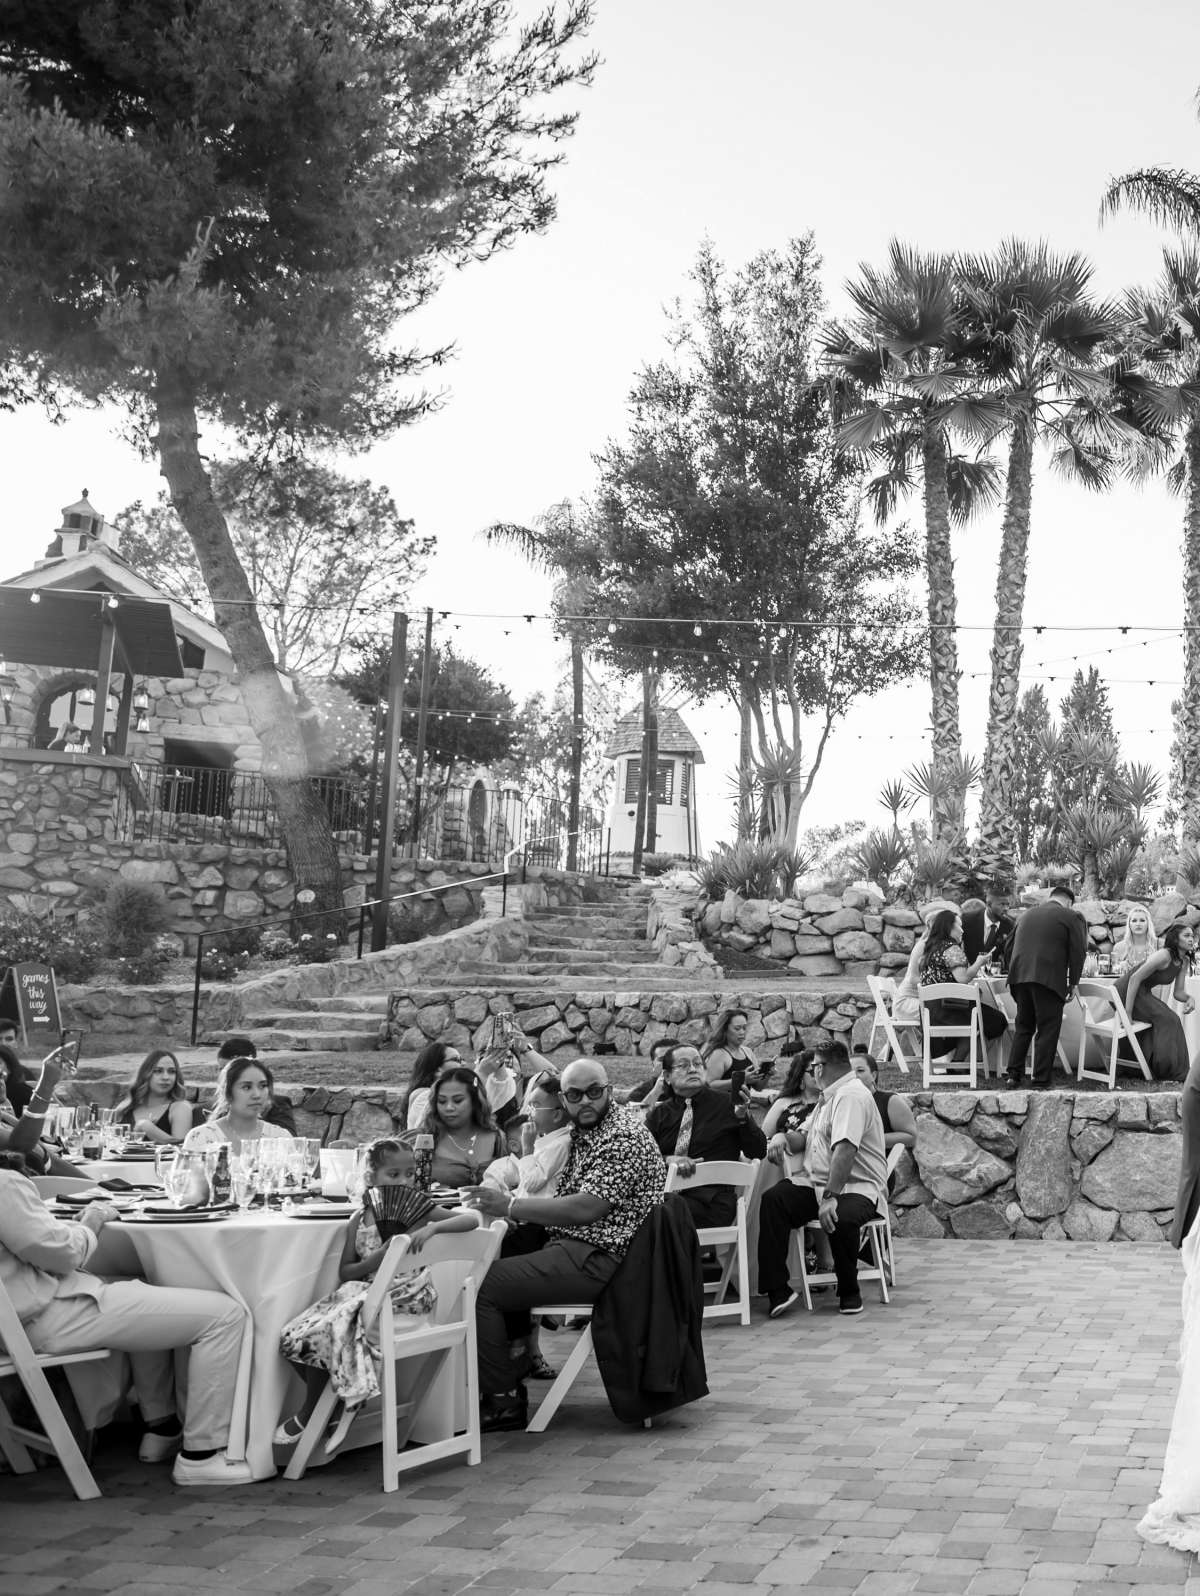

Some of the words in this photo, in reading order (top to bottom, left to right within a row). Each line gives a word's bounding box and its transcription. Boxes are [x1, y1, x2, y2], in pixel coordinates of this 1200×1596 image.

[23, 975, 49, 987] games
[28, 986, 45, 998] this
[29, 1001, 47, 1014] way
